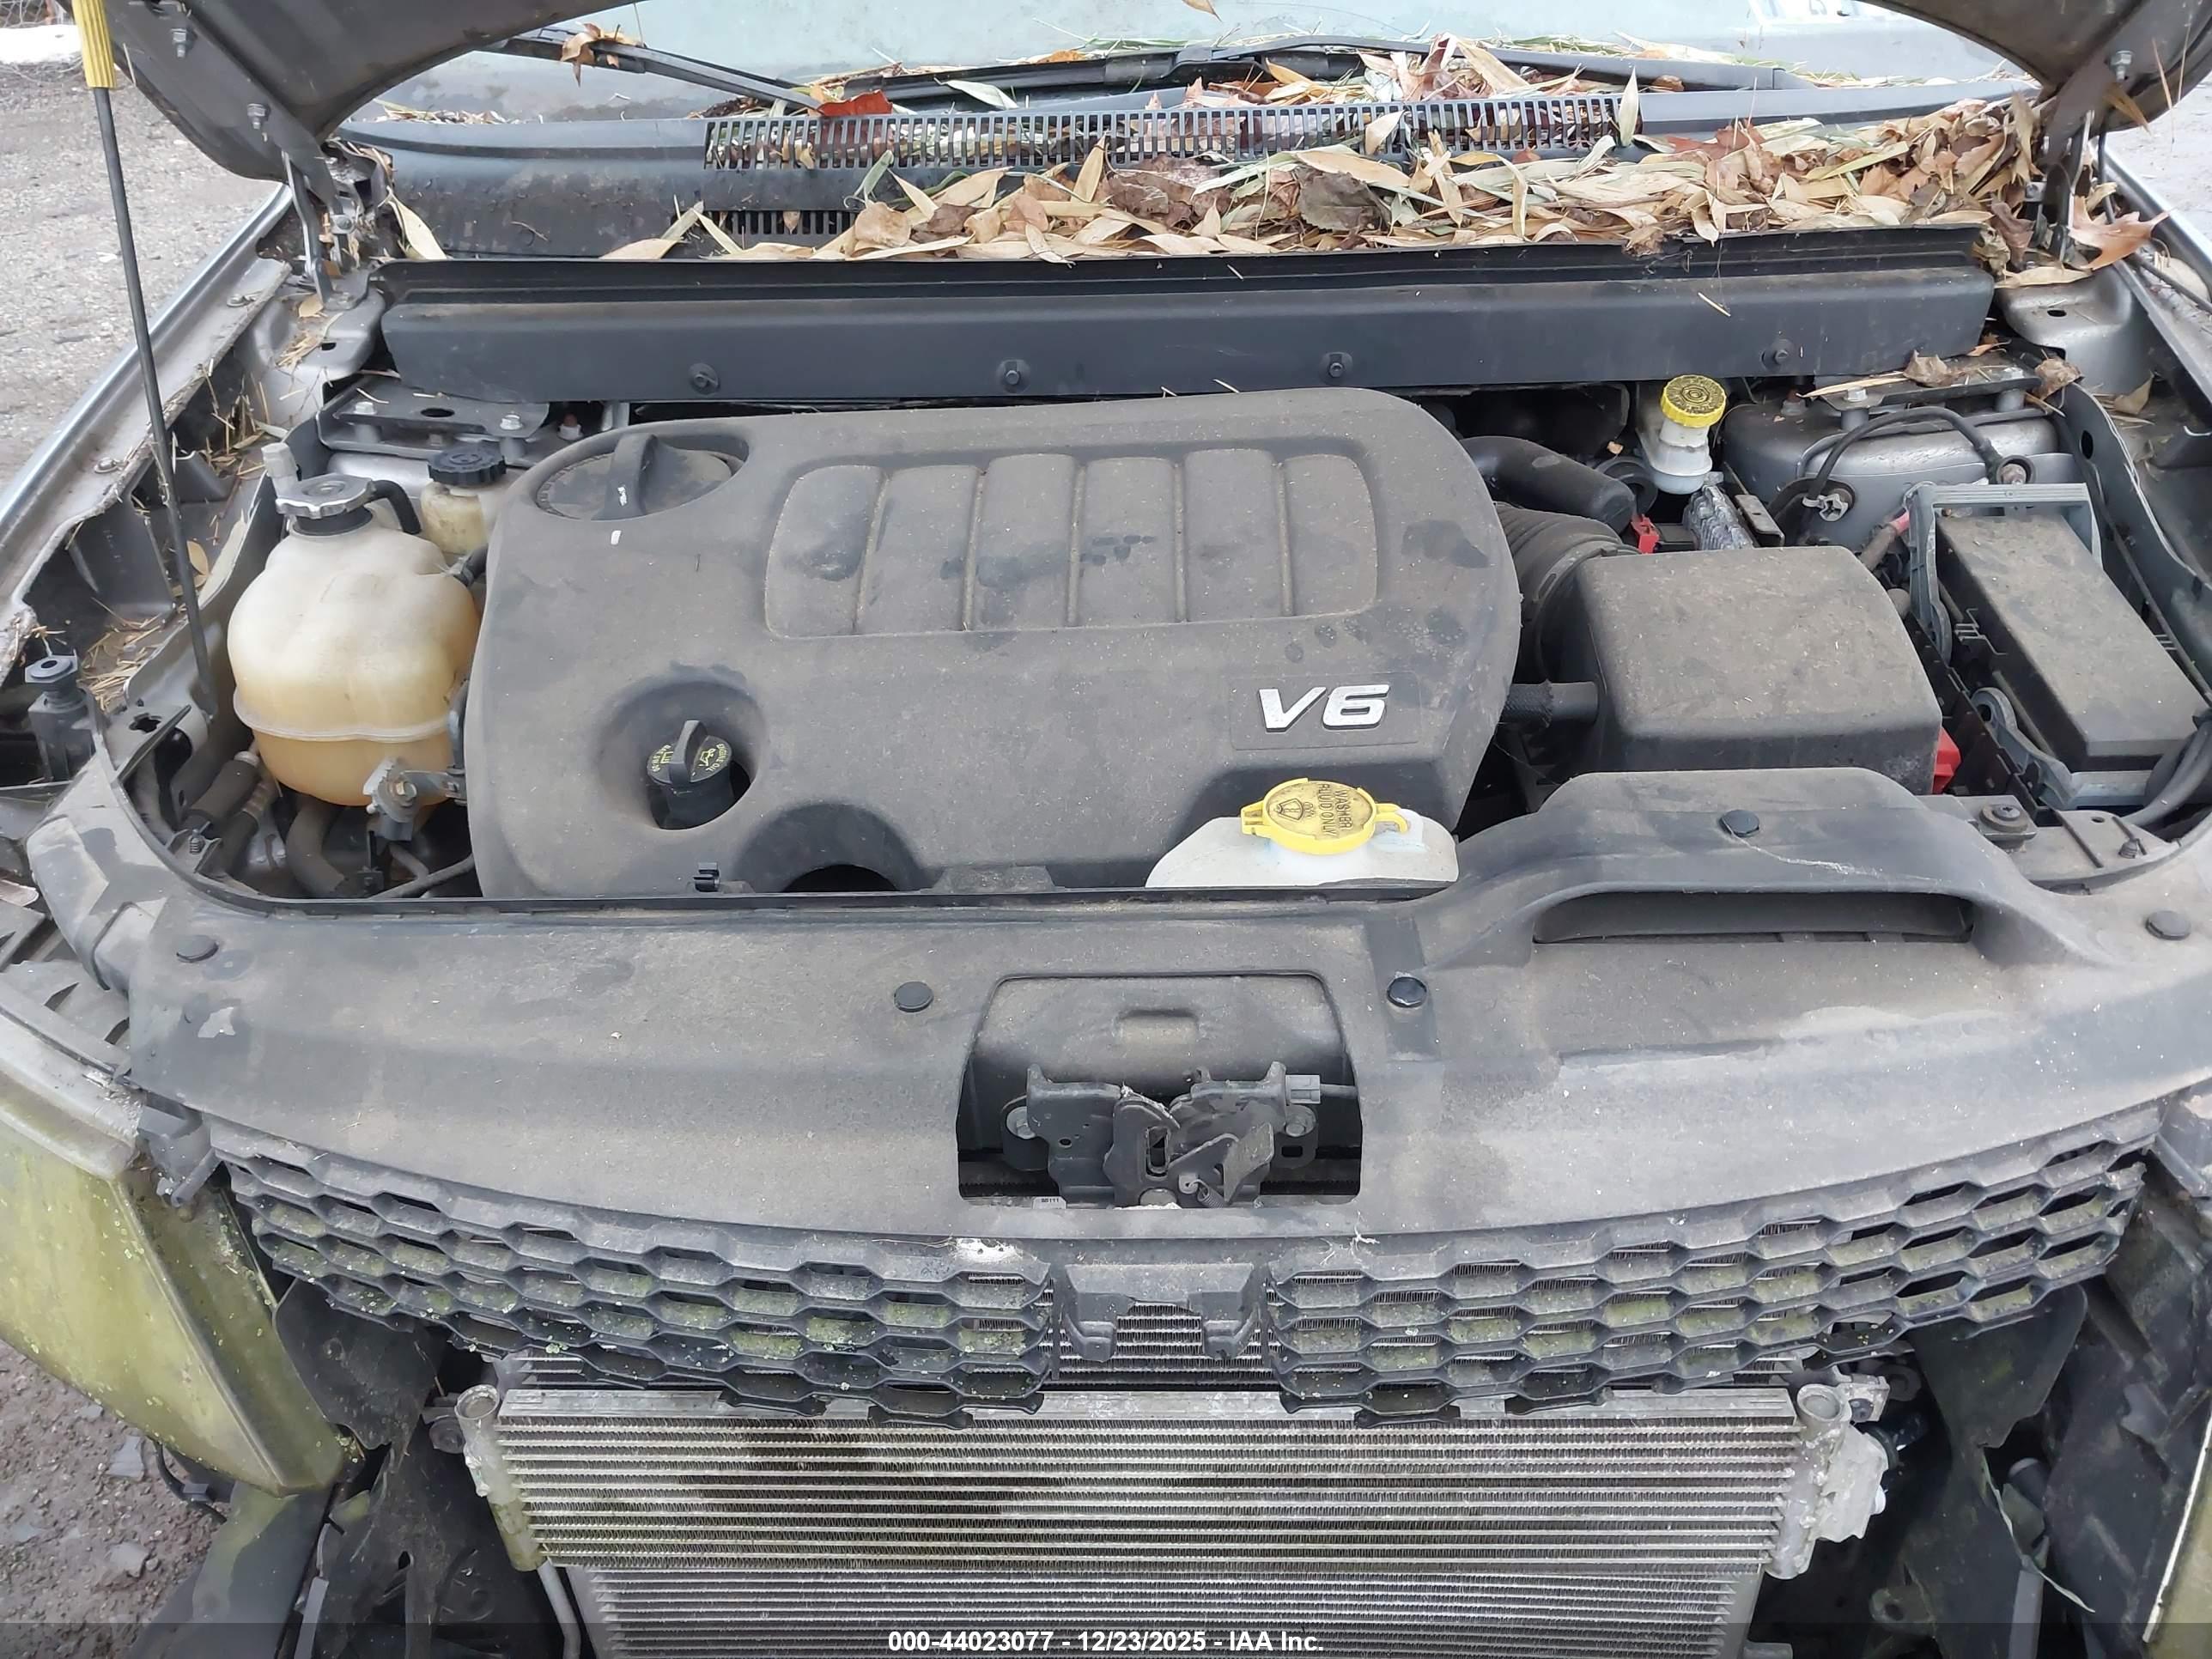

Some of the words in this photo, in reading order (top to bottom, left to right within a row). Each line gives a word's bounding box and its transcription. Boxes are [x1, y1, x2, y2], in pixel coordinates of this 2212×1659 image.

[1258, 684, 1390, 732] V6
[715, 743, 727, 763] ENGINE
[705, 763, 720, 772] OIL
[1318, 783, 1334, 811] FLUID
[1334, 789, 1352, 831] WASHER
[1321, 811, 1338, 836] ONLY
